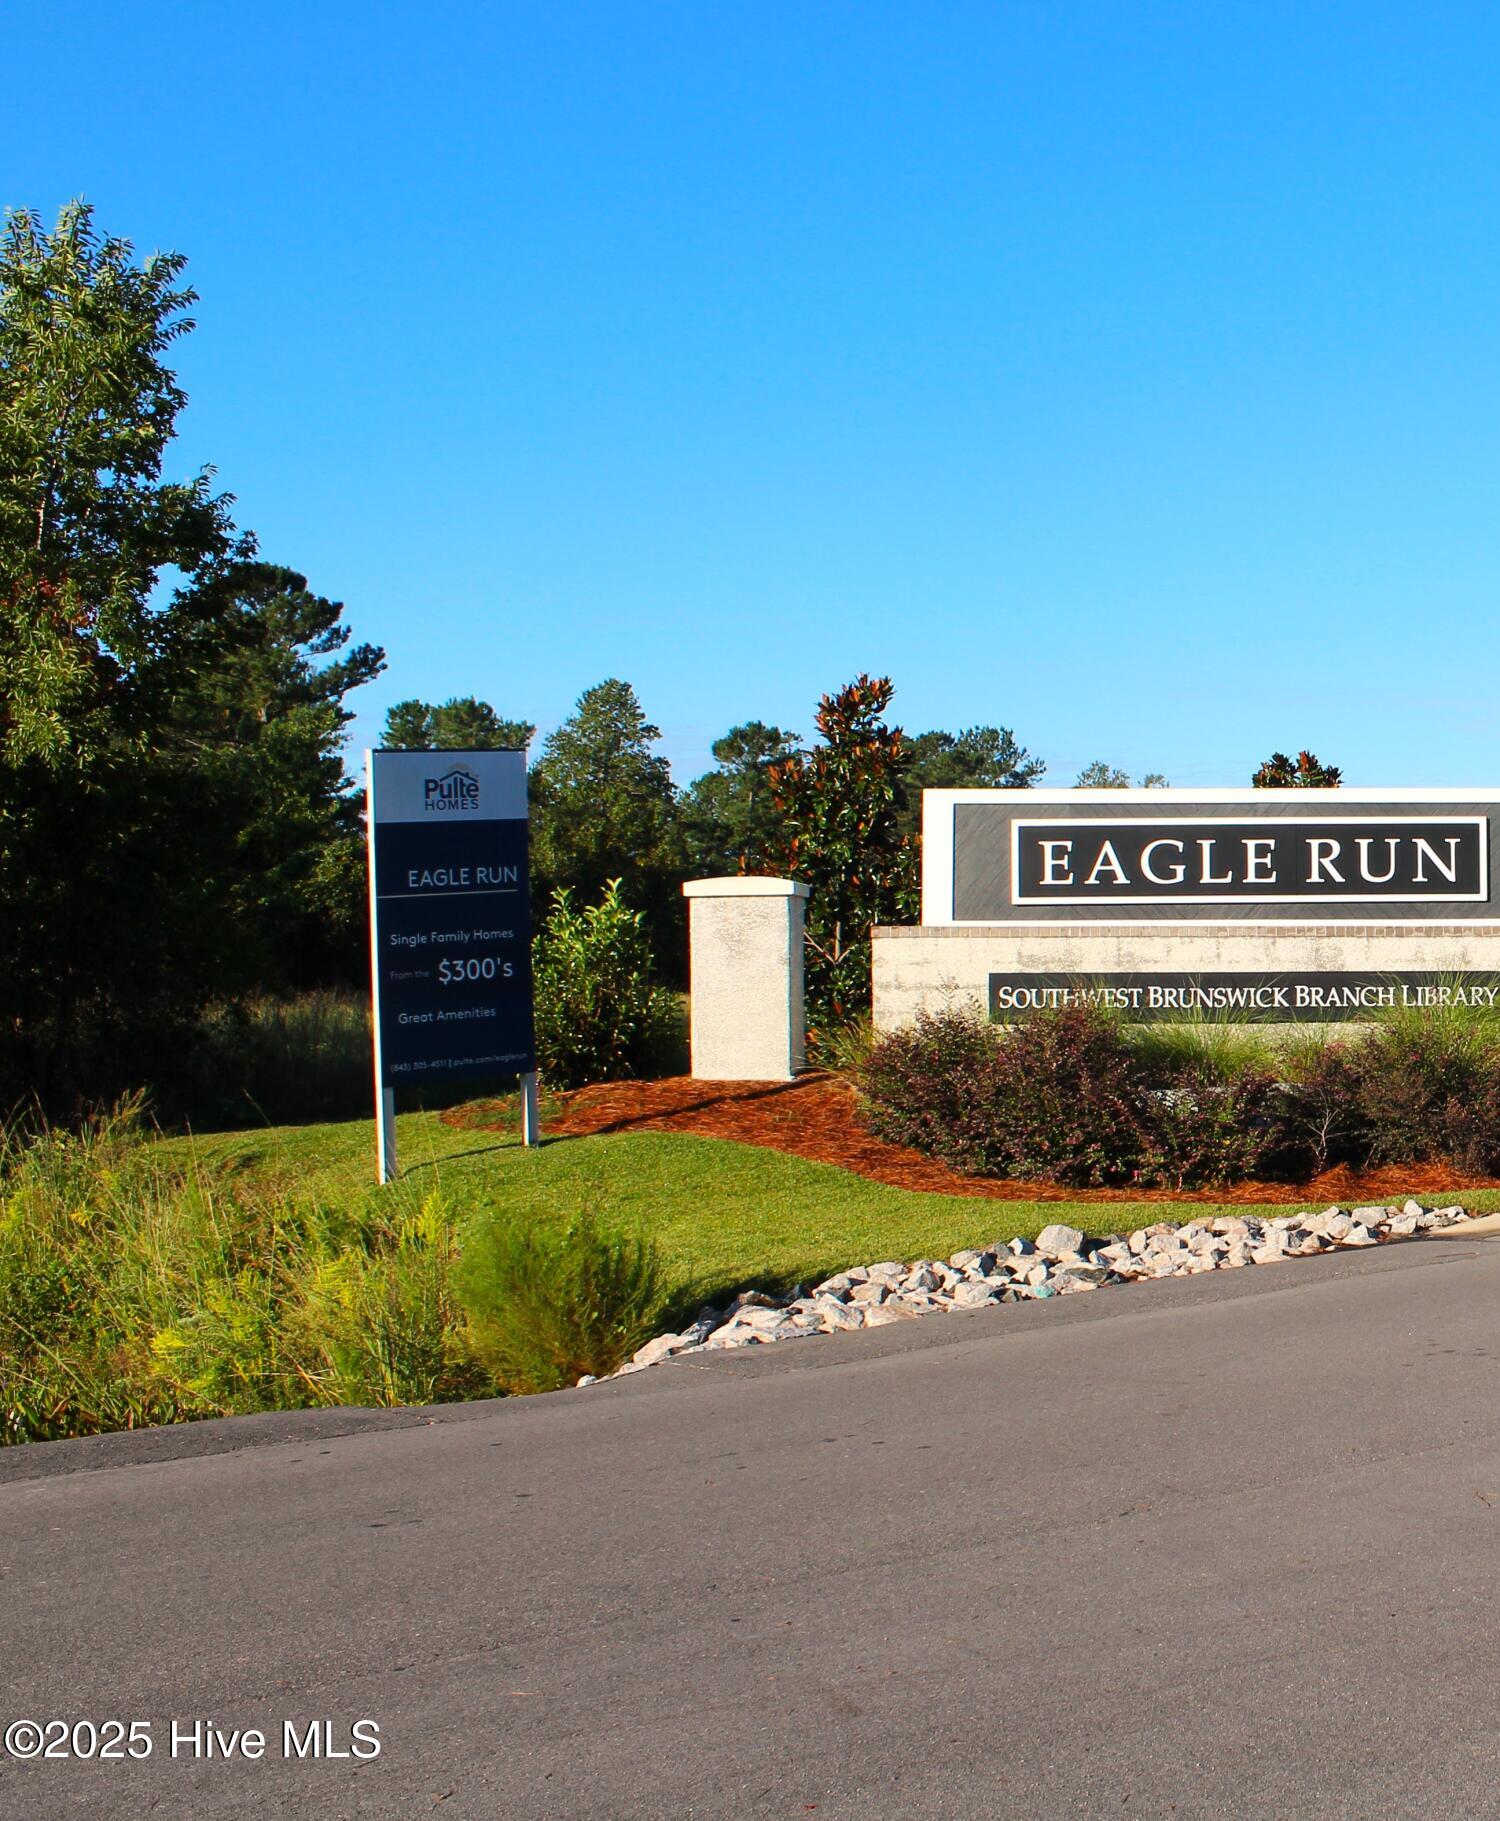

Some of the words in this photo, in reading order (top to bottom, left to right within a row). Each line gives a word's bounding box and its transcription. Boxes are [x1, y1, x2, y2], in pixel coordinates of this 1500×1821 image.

[424, 776, 480, 799] Pulte
[425, 799, 479, 810] HOMES
[1038, 838, 1278, 886] EAGLE
[1305, 837, 1461, 884] RUN
[408, 868, 470, 888] EAGLE
[477, 865, 518, 884] RUN
[390, 932, 428, 947] Single
[431, 930, 471, 943] Family
[473, 928, 514, 940] Homes
[390, 970, 413, 981] From
[438, 957, 513, 985] $300's
[1148, 986, 1290, 1009] BRUNSWICK
[1295, 985, 1396, 1008] BRANCH
[1400, 984, 1499, 1007] LIBRARY
[398, 1012, 434, 1024] Great
[436, 1006, 497, 1021] Amenities
